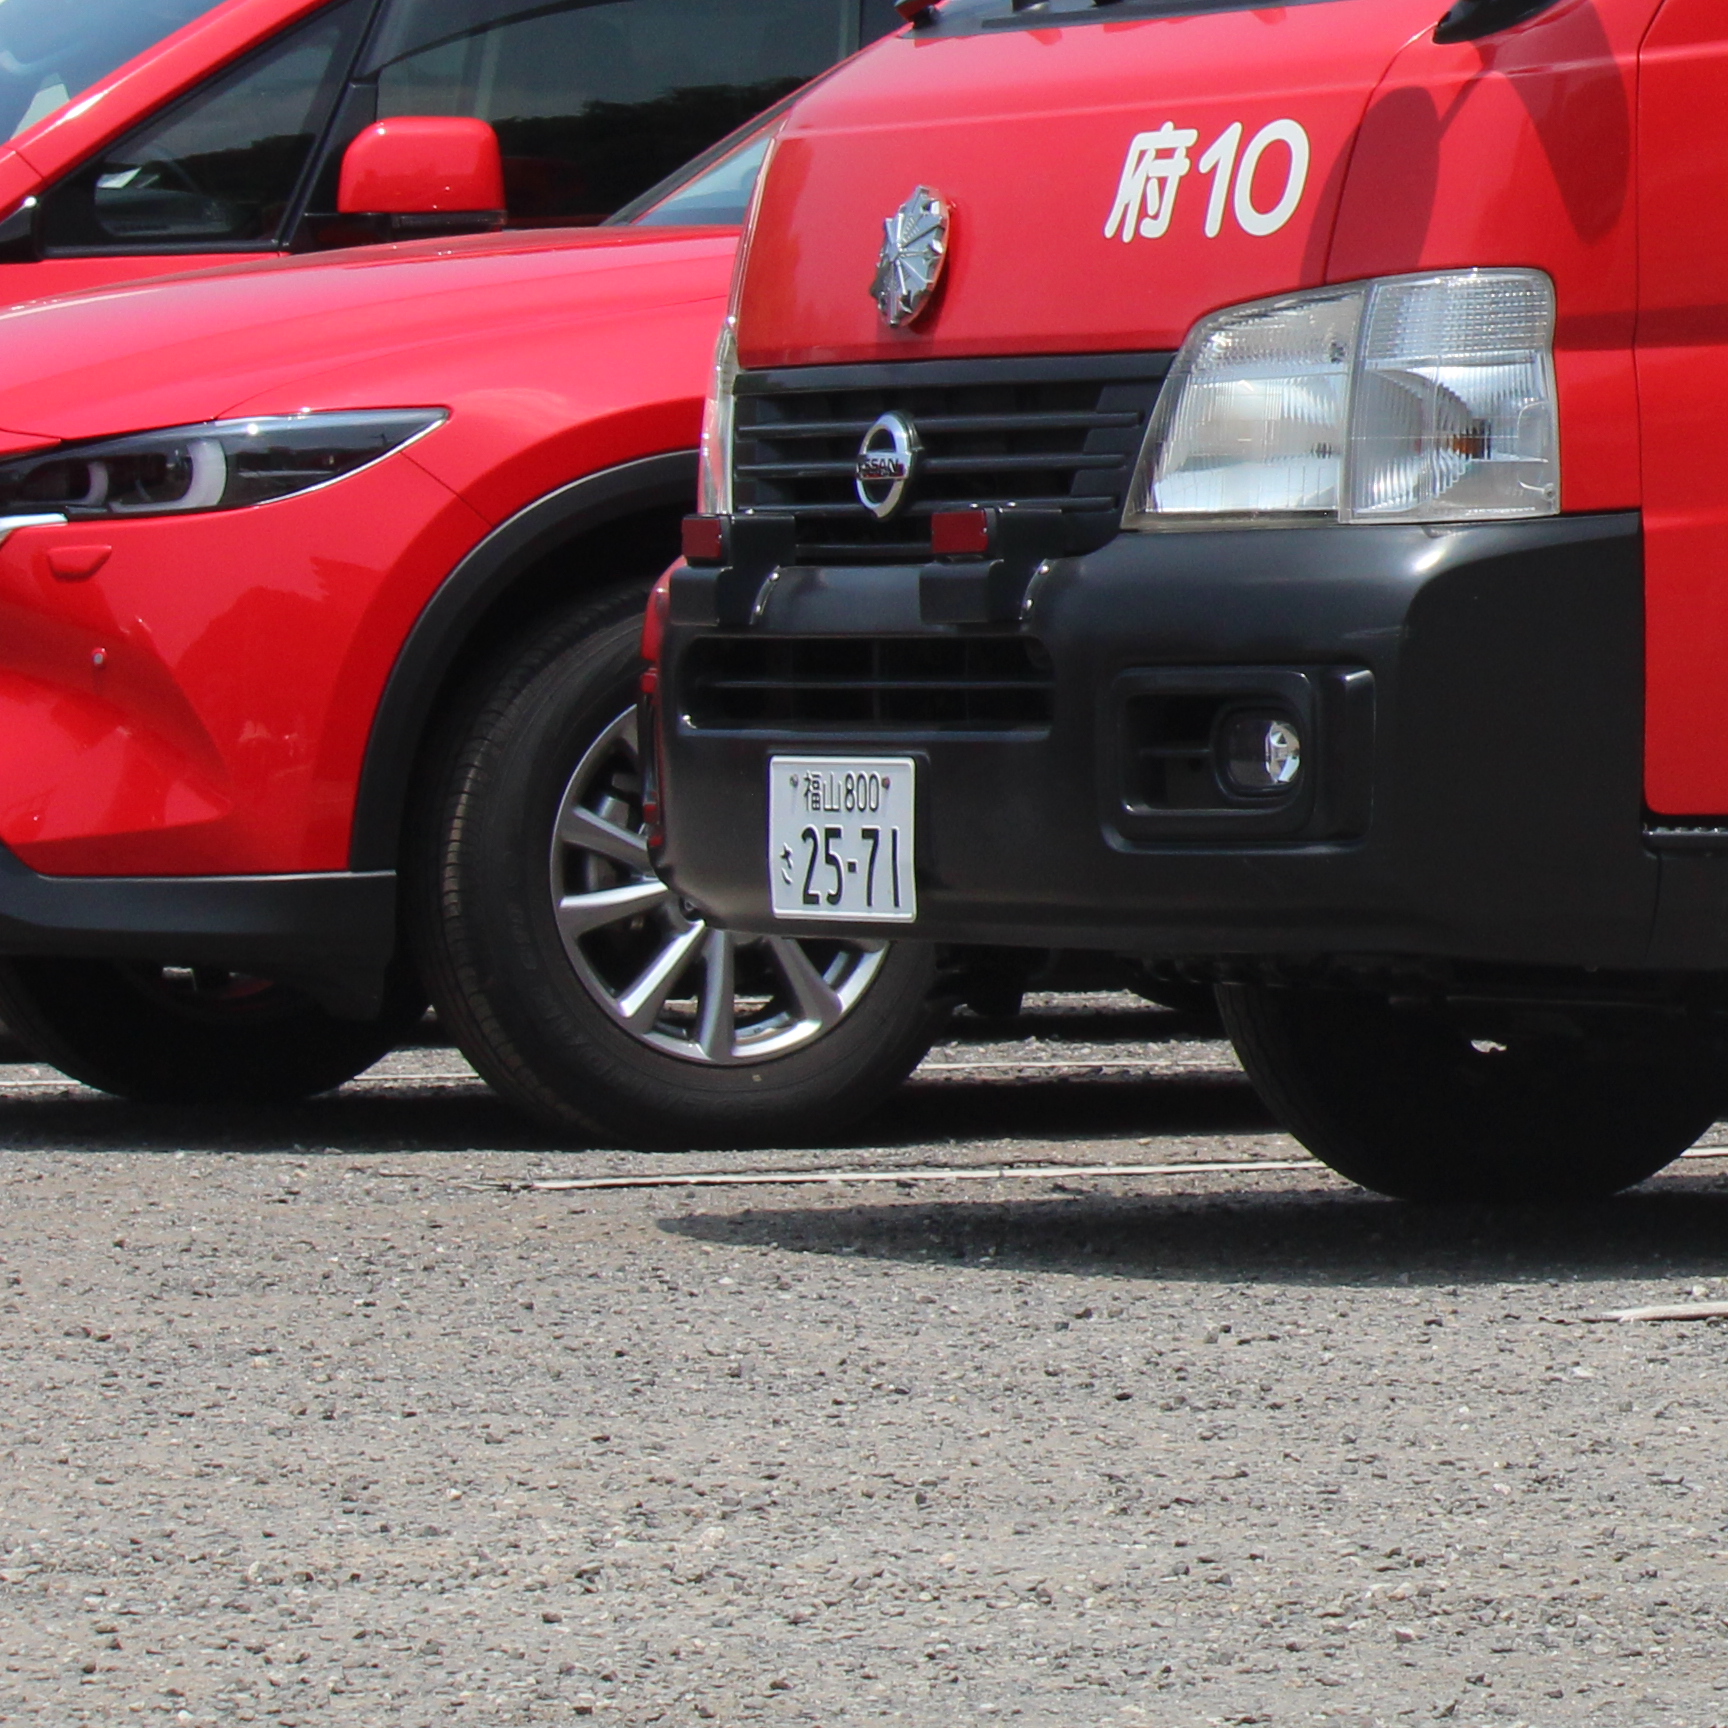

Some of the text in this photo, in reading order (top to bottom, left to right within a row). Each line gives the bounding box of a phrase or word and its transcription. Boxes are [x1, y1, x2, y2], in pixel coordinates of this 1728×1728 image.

[1103, 118, 1311, 243] 府10
[803, 770, 882, 814] 福山800
[779, 824, 901, 909] さ 25-71
